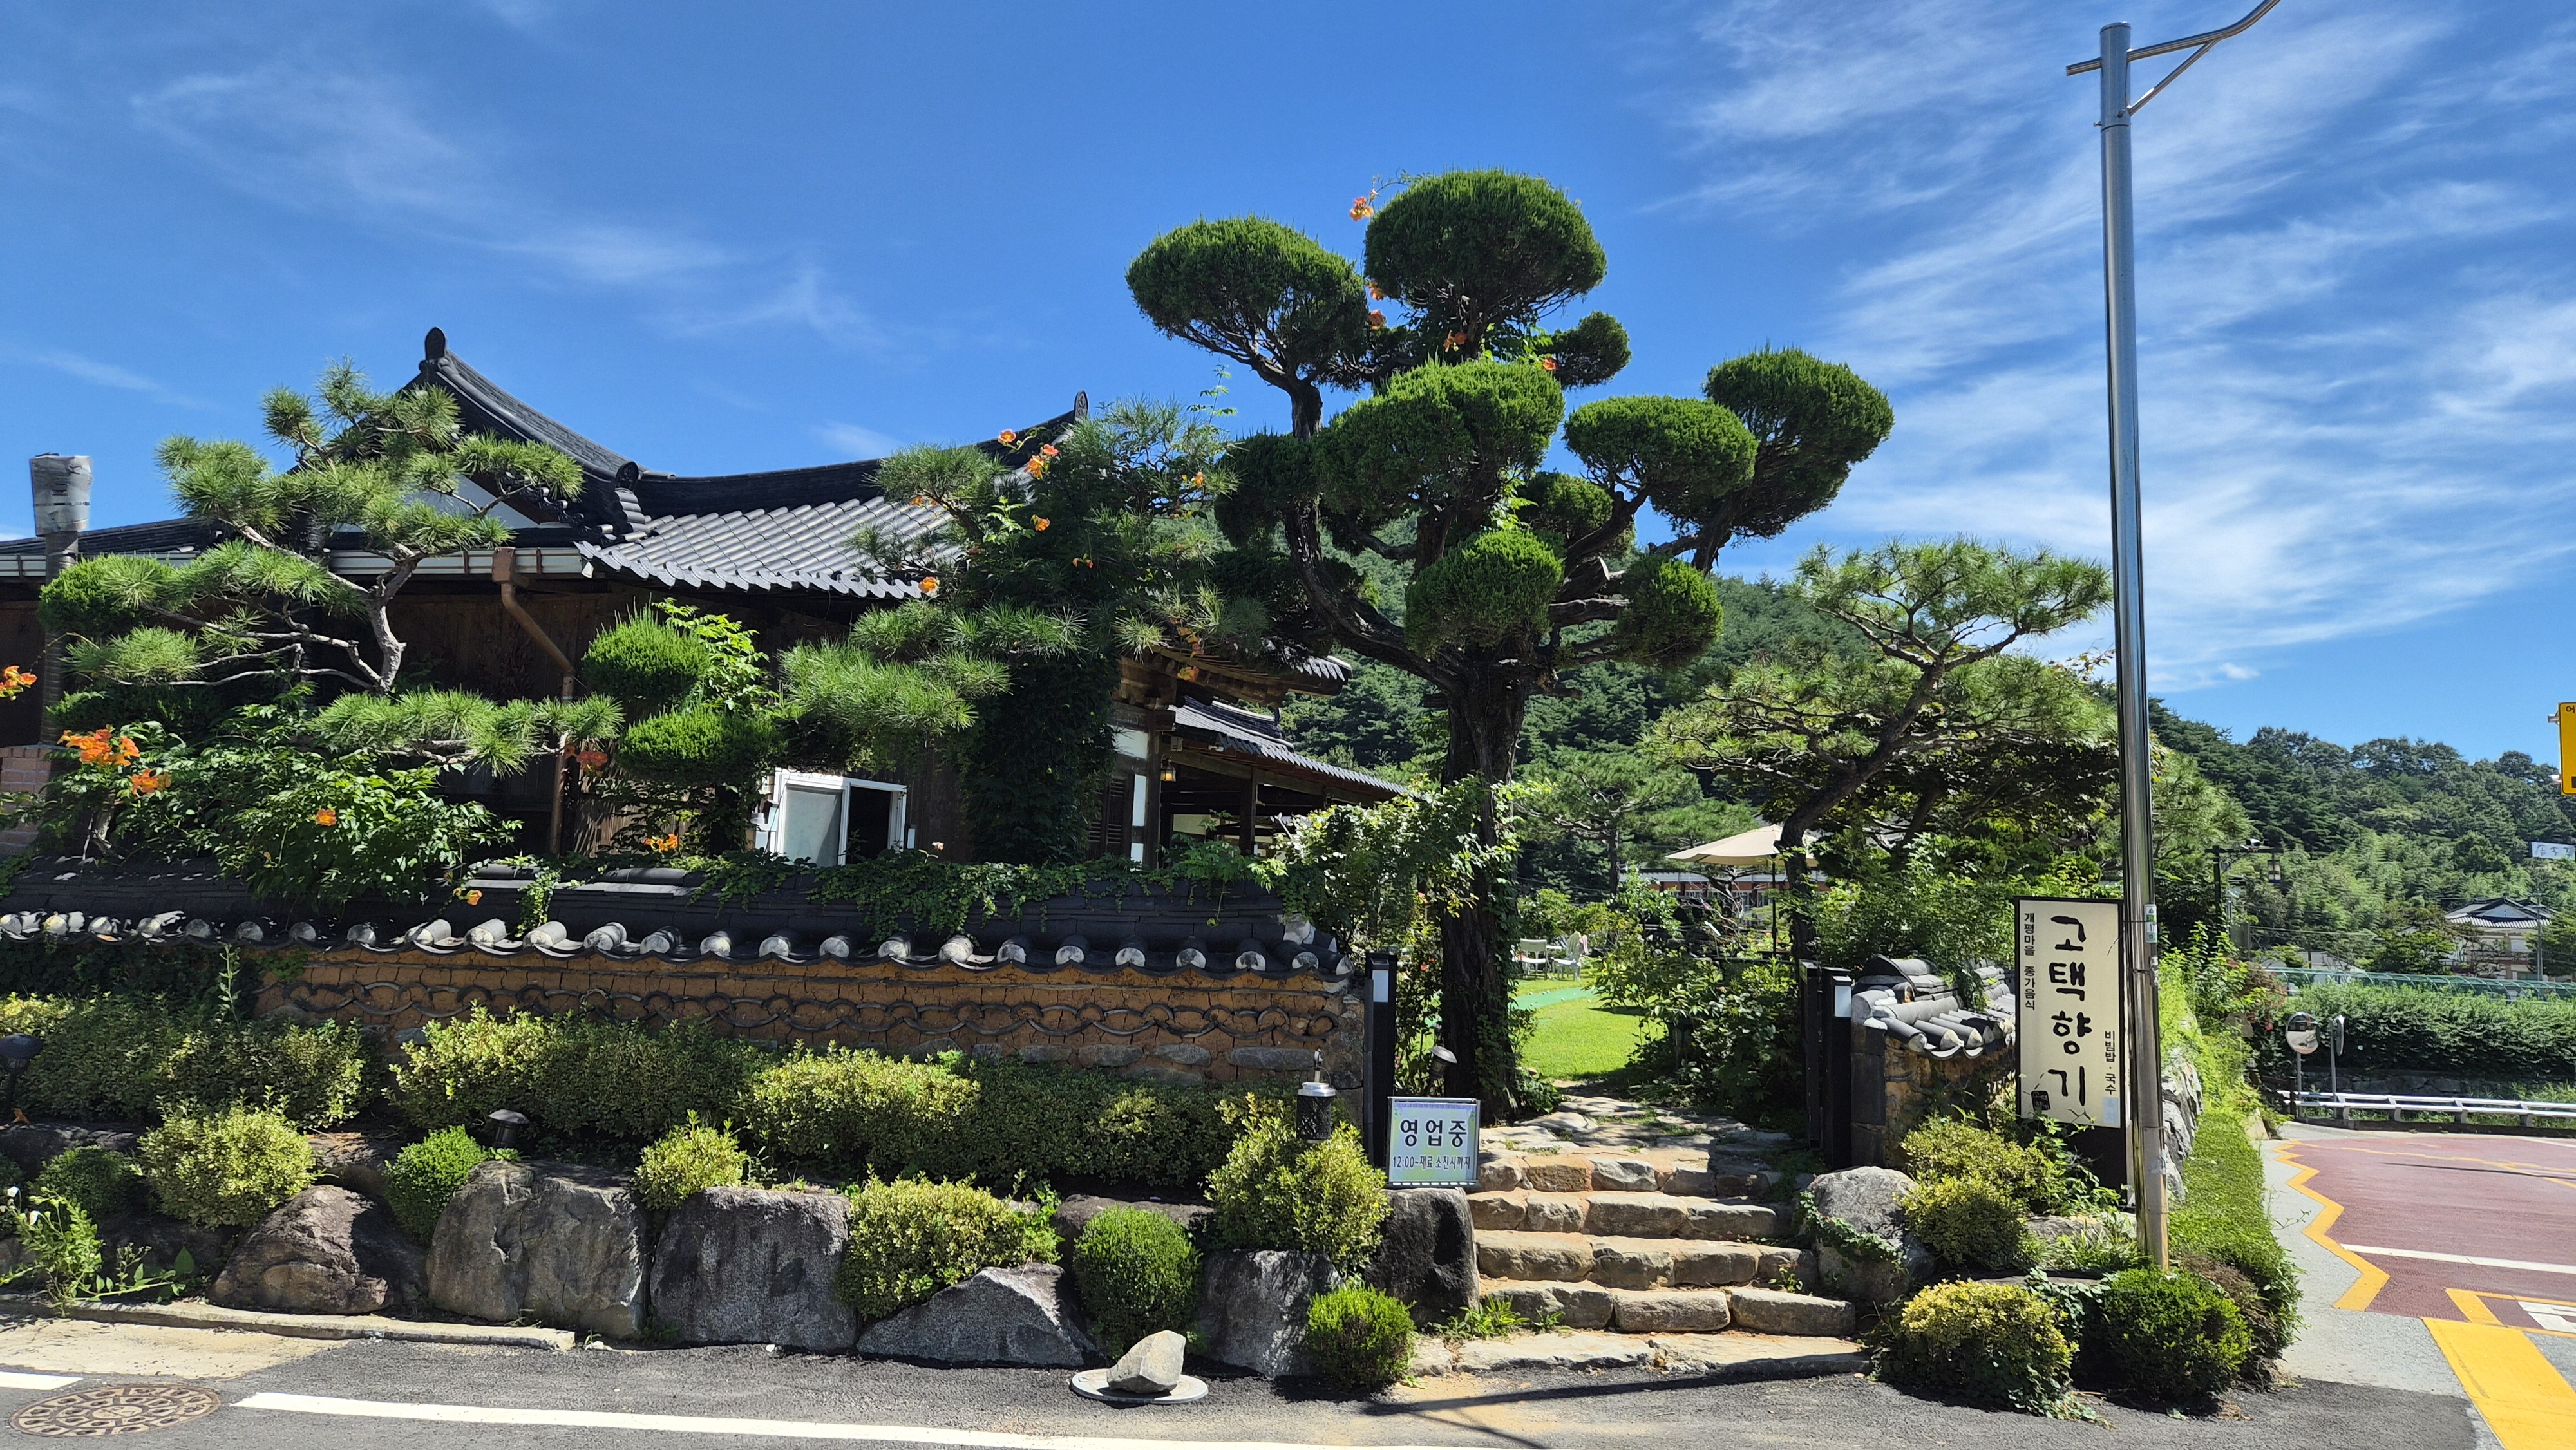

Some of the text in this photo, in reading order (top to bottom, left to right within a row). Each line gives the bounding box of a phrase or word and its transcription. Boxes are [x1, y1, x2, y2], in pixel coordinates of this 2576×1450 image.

[2023, 912, 2036, 1011] 개평마을 종가음식
[2048, 915, 2093, 1107] 고택향기
[1400, 1119, 1467, 1147] 영업중
[1435, 1156, 1471, 1170] 소진시까지
